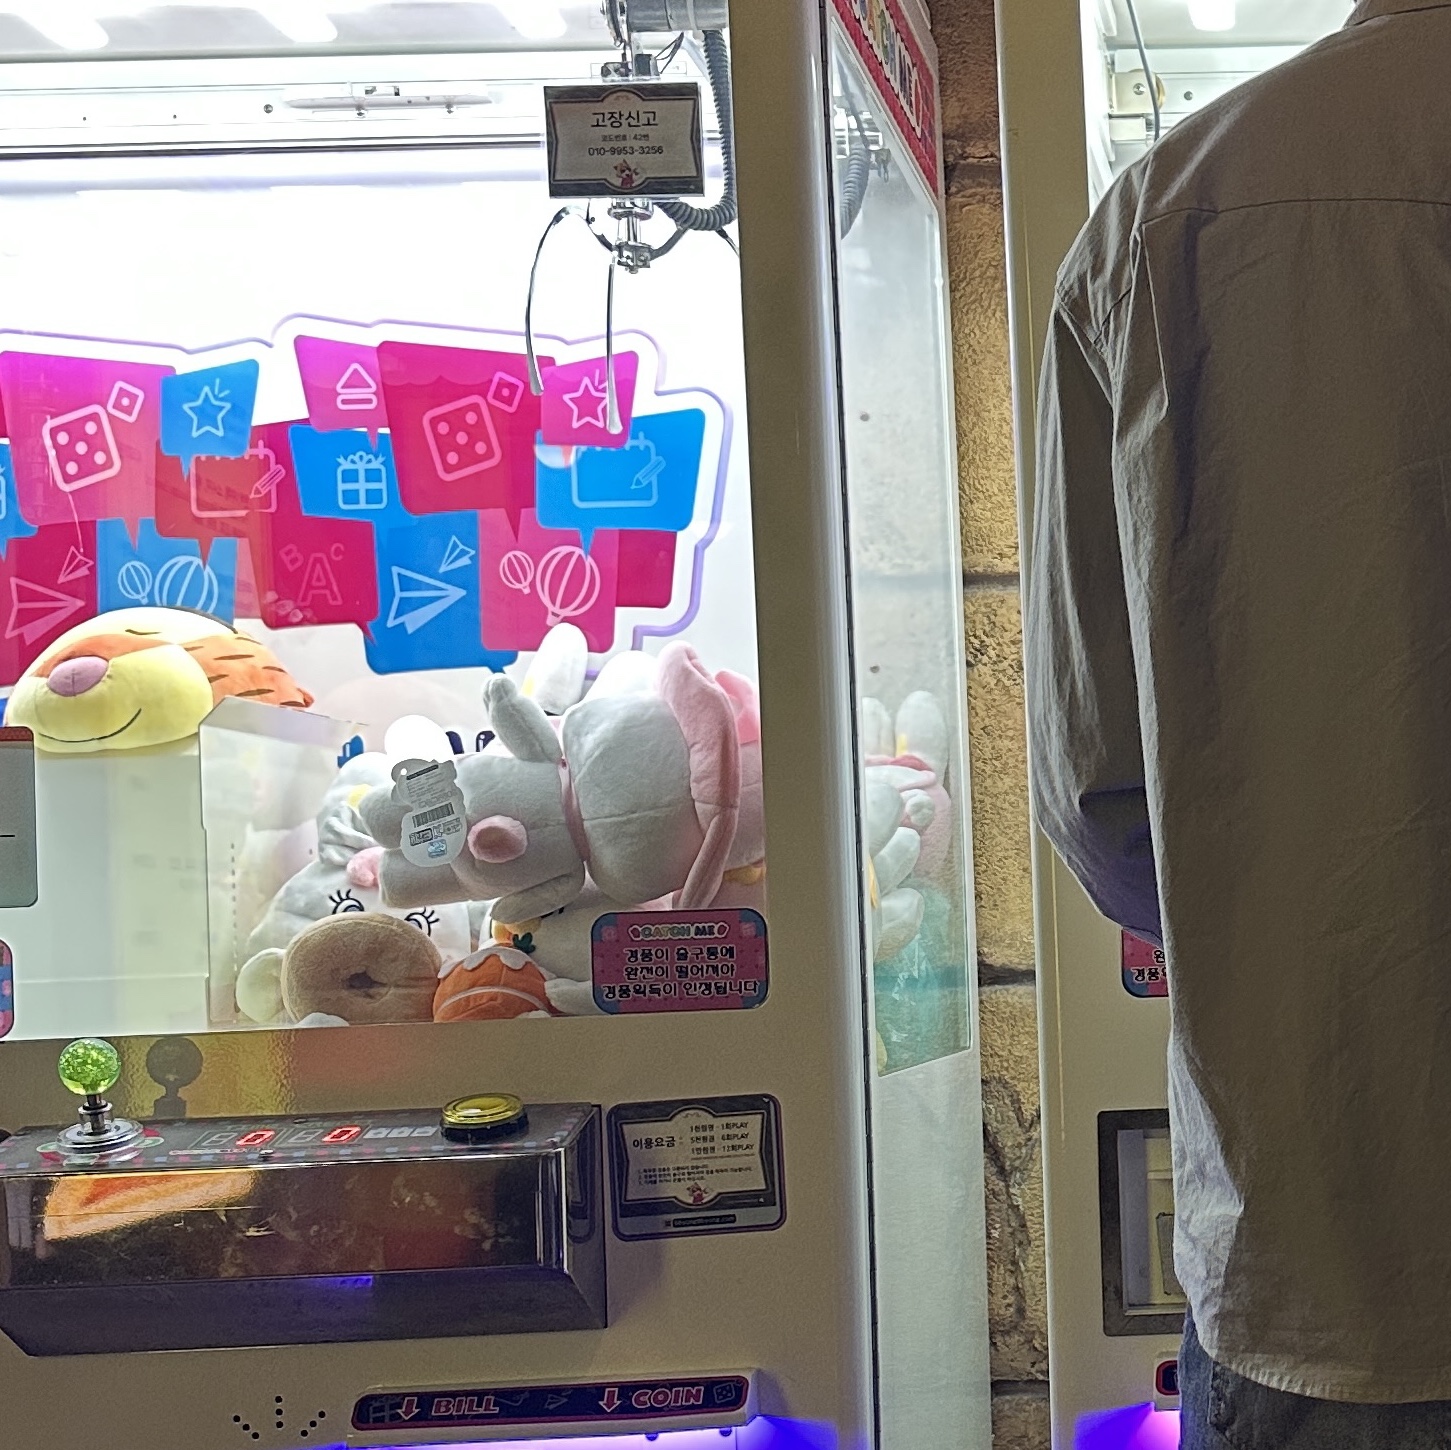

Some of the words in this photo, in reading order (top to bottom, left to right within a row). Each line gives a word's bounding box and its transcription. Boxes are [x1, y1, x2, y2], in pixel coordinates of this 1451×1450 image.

[591, 110, 658, 128] 고장신고
[588, 146, 663, 156] 010-9953-3256
[640, 925, 691, 938] CATCH
[625, 948, 669, 963] 경품이
[676, 946, 735, 961] 출구통에
[676, 964, 735, 979] 떨어져야
[603, 983, 677, 1000] 경품획득이
[683, 980, 758, 997] 인정됩니다
[633, 1136, 675, 1150] 이용요금
[431, 1395, 500, 1416] BILL
[631, 1386, 704, 1409] COIN
